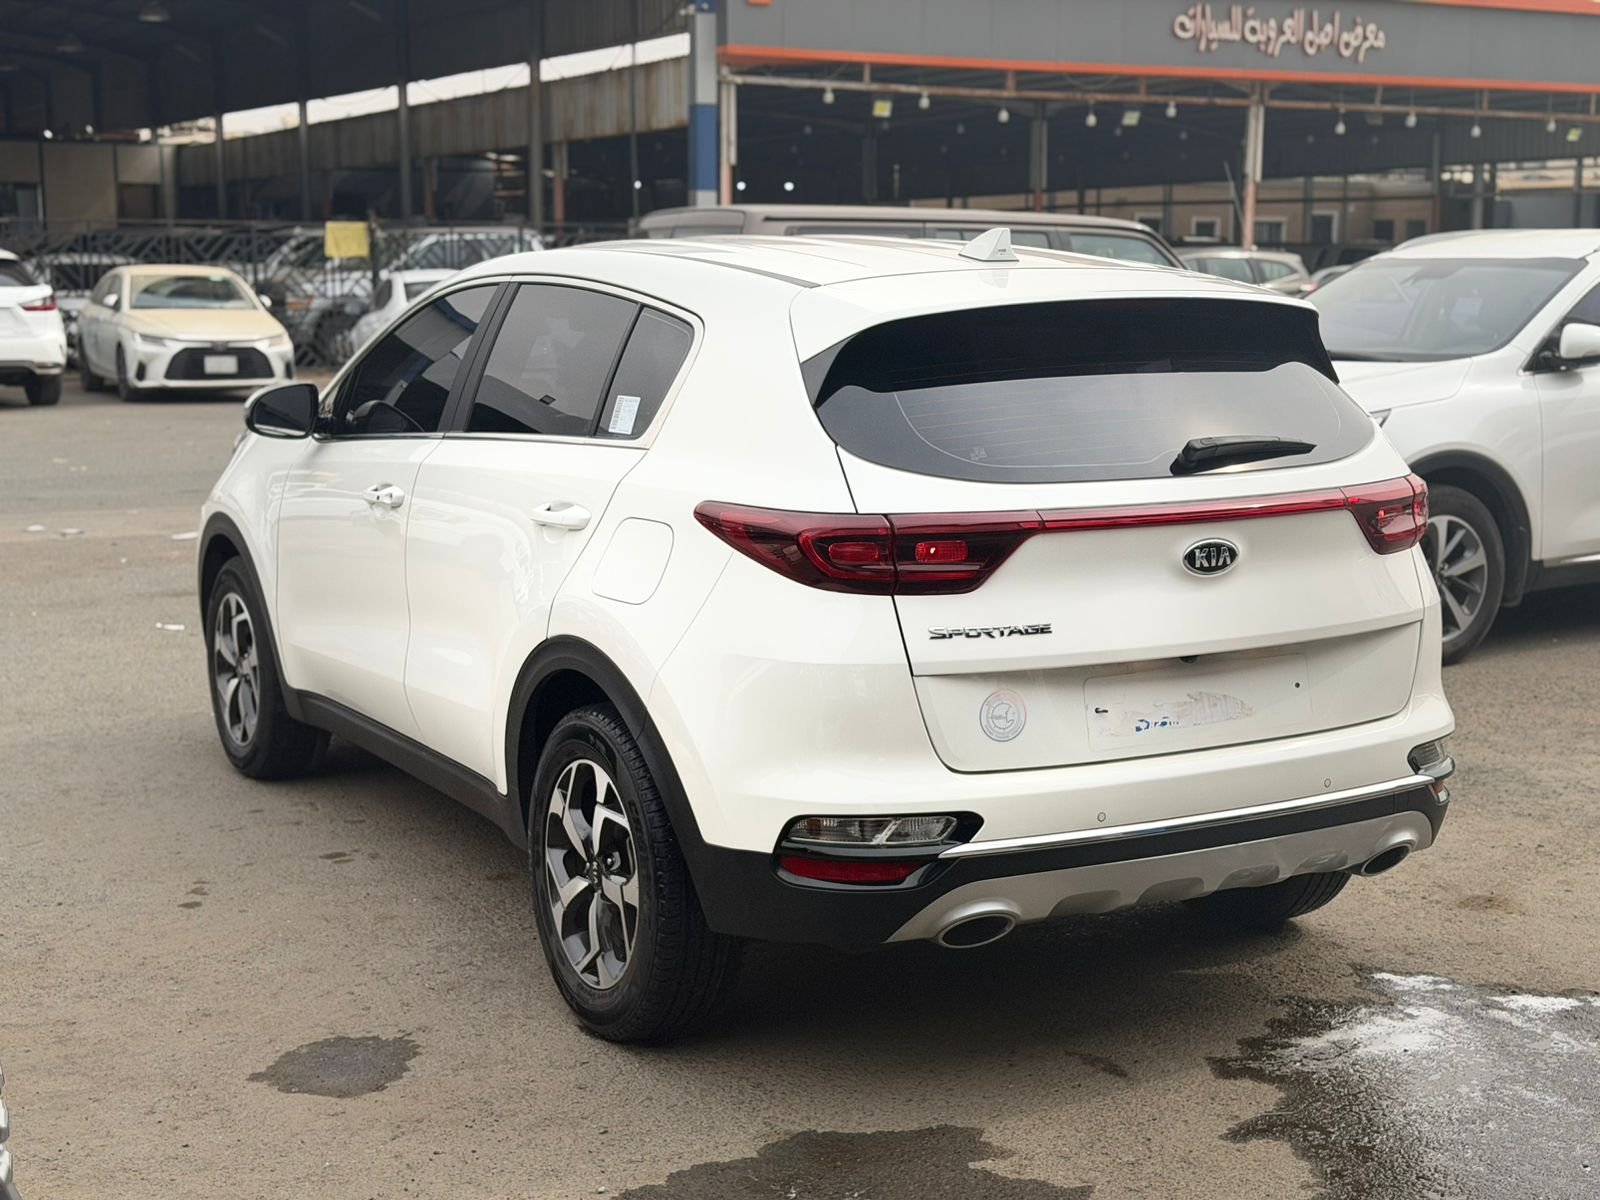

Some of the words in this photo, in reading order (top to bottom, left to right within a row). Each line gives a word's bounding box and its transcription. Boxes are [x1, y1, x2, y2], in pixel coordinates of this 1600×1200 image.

[1173, 3, 1242, 52] للسيارات
[1339, 15, 1386, 64] معرض
[1193, 546, 1232, 568] KIA
[927, 623, 1053, 640] SPORTAGE
